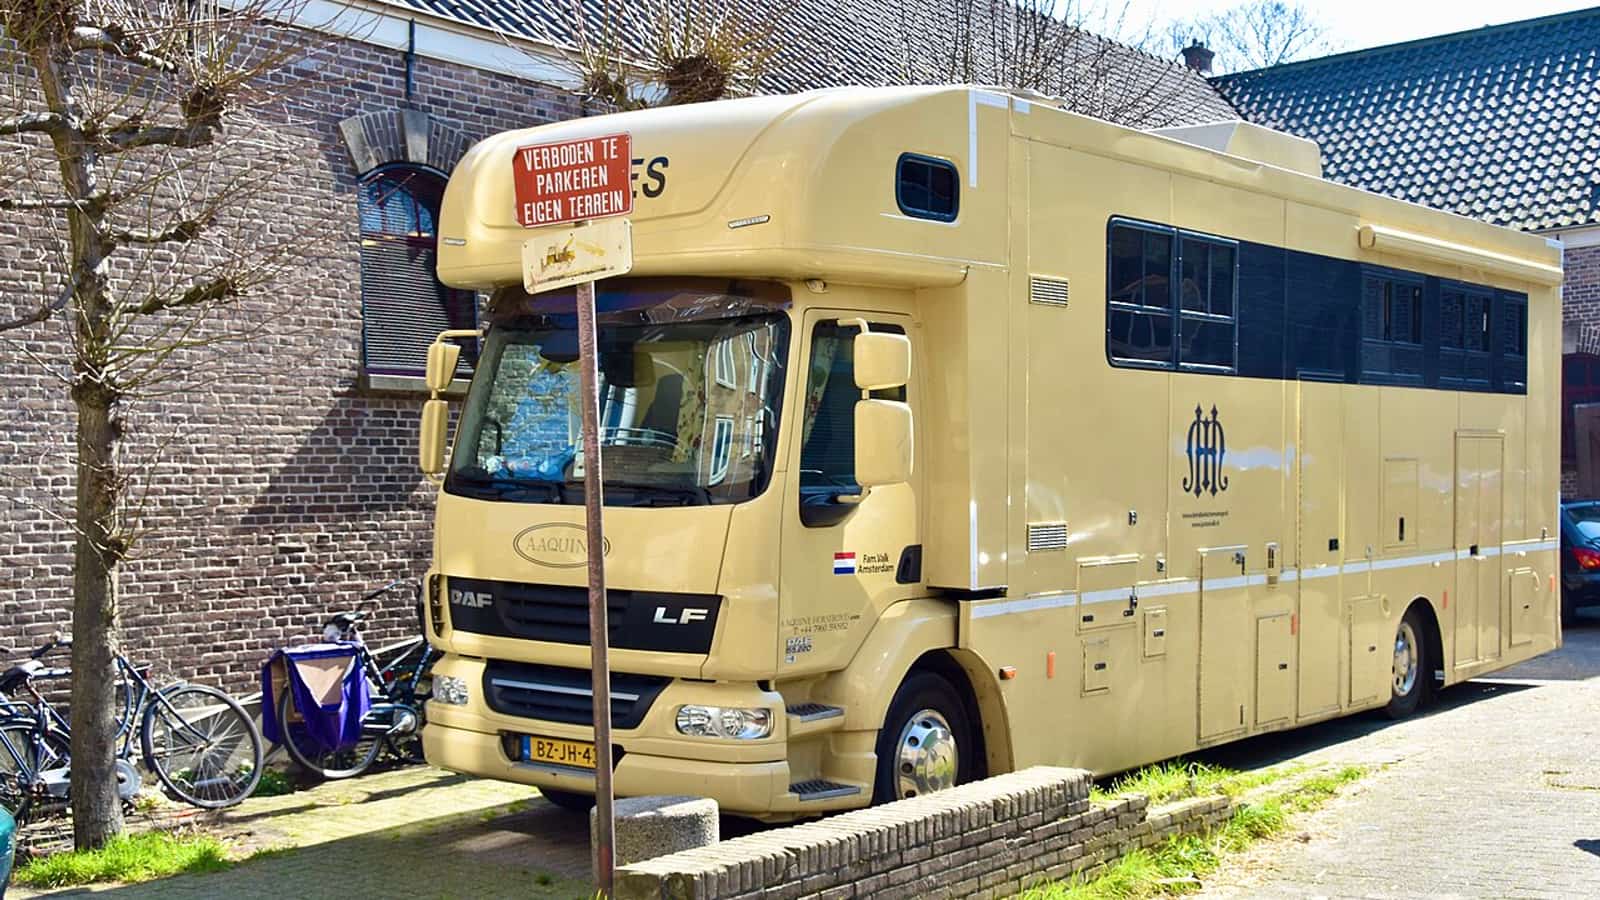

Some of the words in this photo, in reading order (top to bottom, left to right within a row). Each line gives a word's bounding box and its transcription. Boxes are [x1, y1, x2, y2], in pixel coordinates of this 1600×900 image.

[523, 141, 594, 171] VERBODEN
[601, 138, 618, 160] TE
[537, 165, 608, 195] PARKEREN
[524, 199, 562, 225] EIGEN
[569, 190, 624, 217] TERREIN
[526, 536, 587, 554] AAQUIN
[858, 564, 895, 574] Amsterdam
[451, 589, 492, 608] DAF
[653, 606, 708, 625] LF
